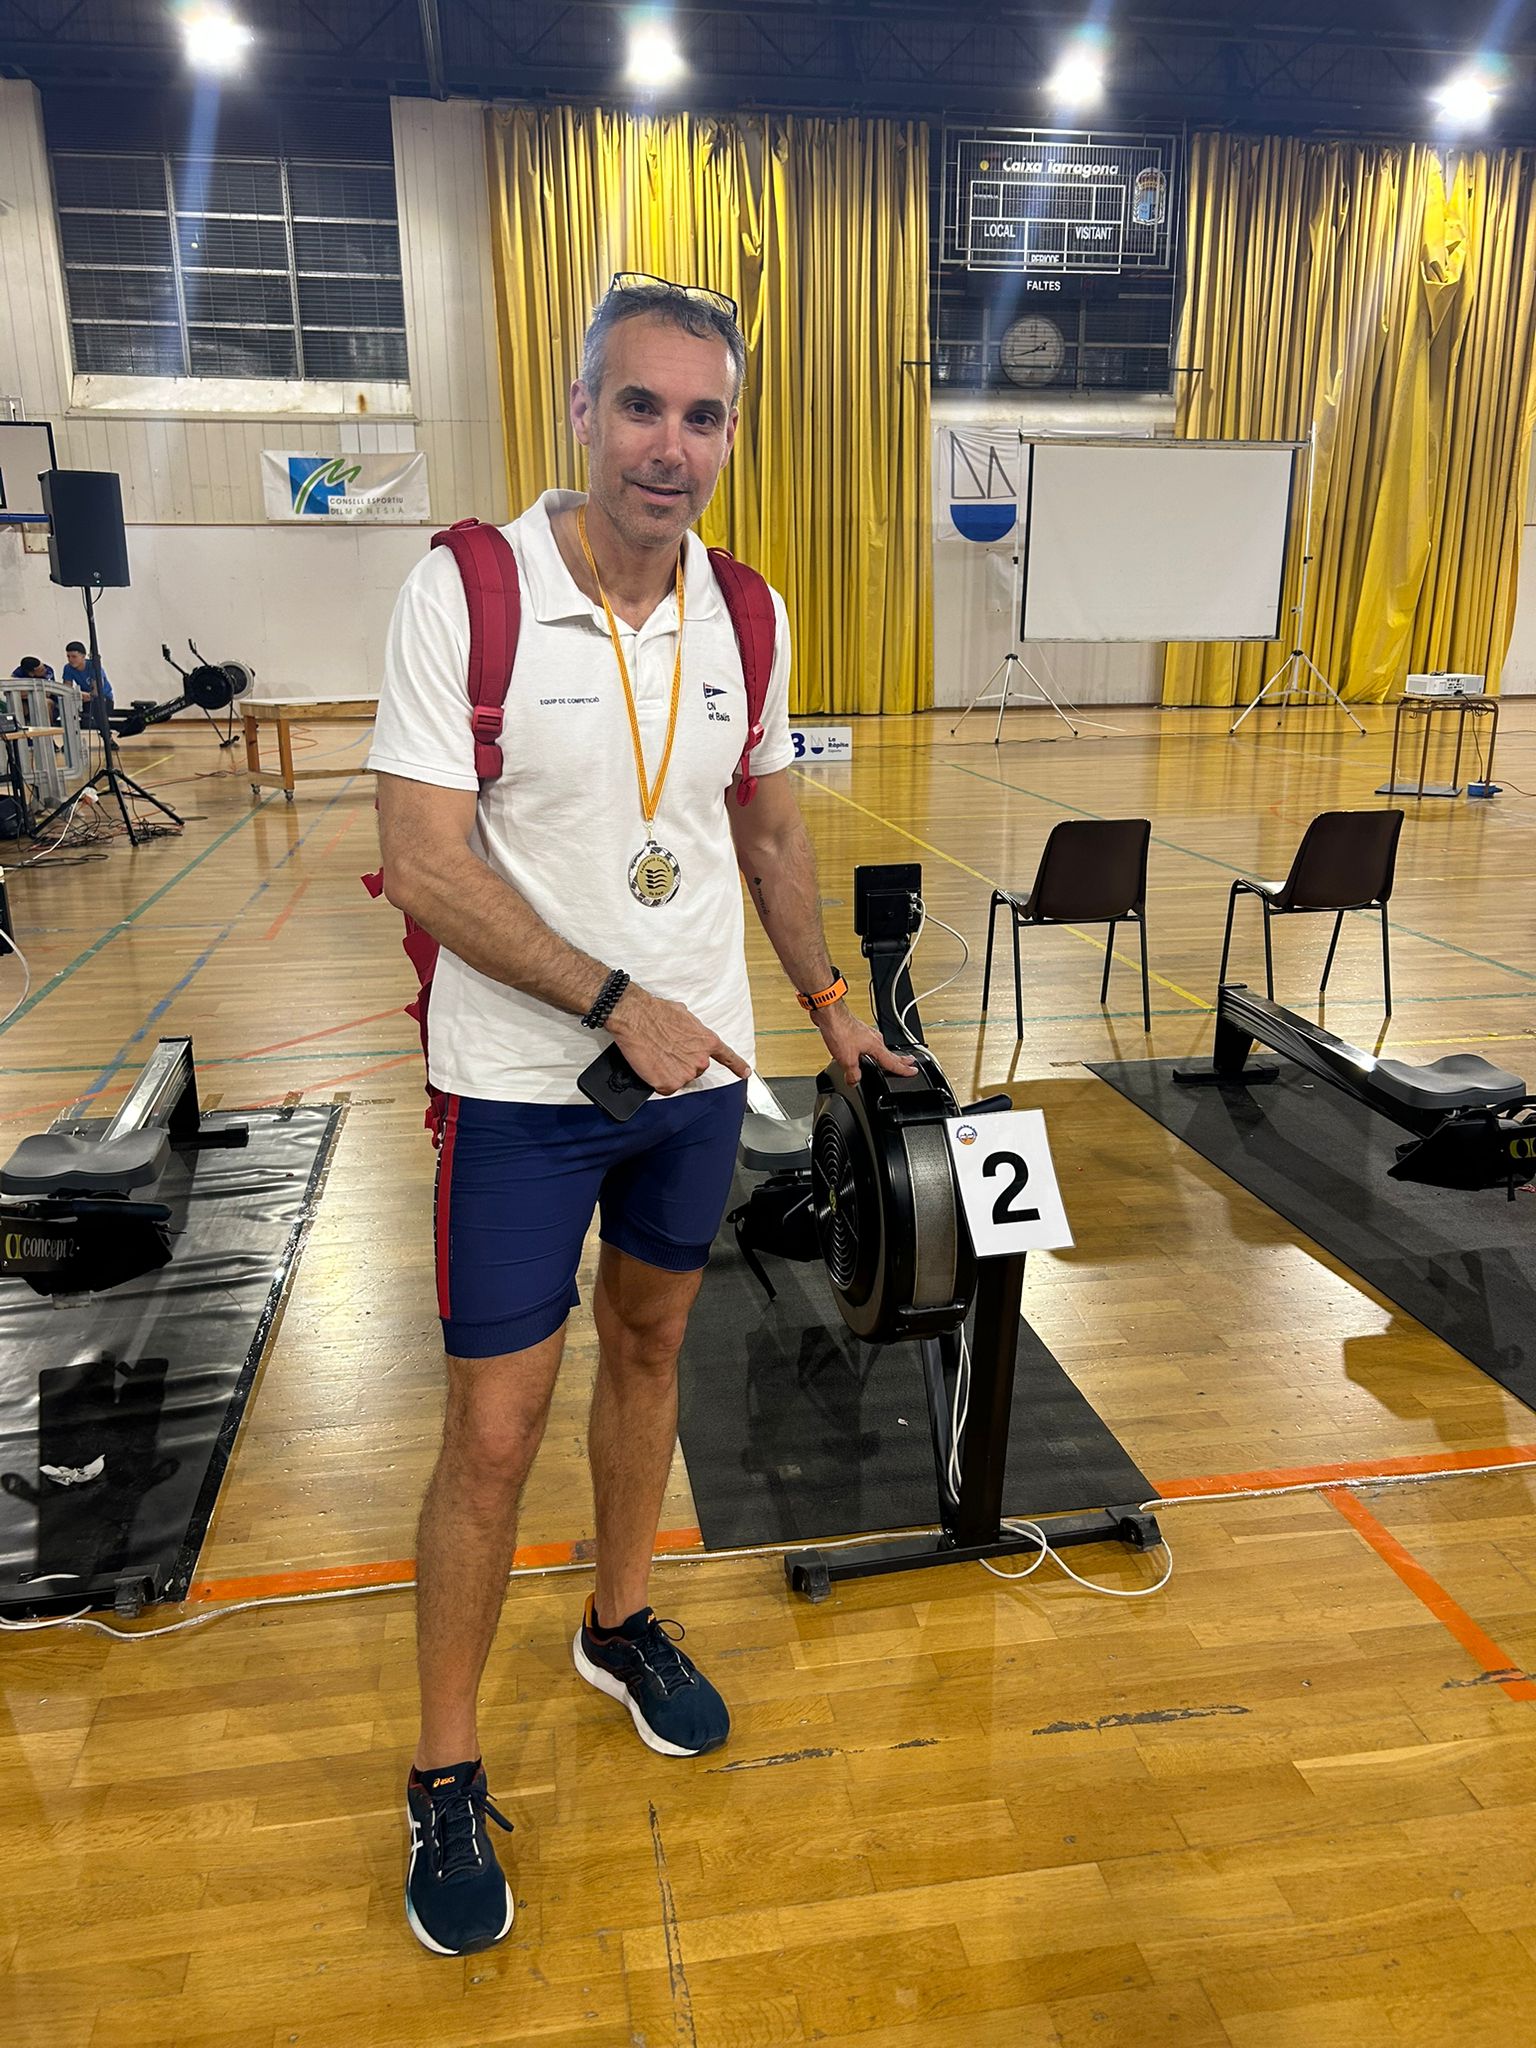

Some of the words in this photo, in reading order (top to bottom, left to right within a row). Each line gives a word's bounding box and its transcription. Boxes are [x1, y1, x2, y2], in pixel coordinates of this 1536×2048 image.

[1002, 157, 1042, 173] Caixa
[1047, 159, 1119, 178] Tarragona
[984, 223, 1016, 238] LOCAL
[1075, 226, 1113, 240] VISITANT
[1026, 280, 1061, 291] FALTES
[367, 497, 404, 505] ESPORTIU
[540, 698, 557, 706] EQUIP
[706, 701, 717, 711] CN
[982, 1150, 1041, 1225] 2
[23, 1237, 67, 1260] concept
